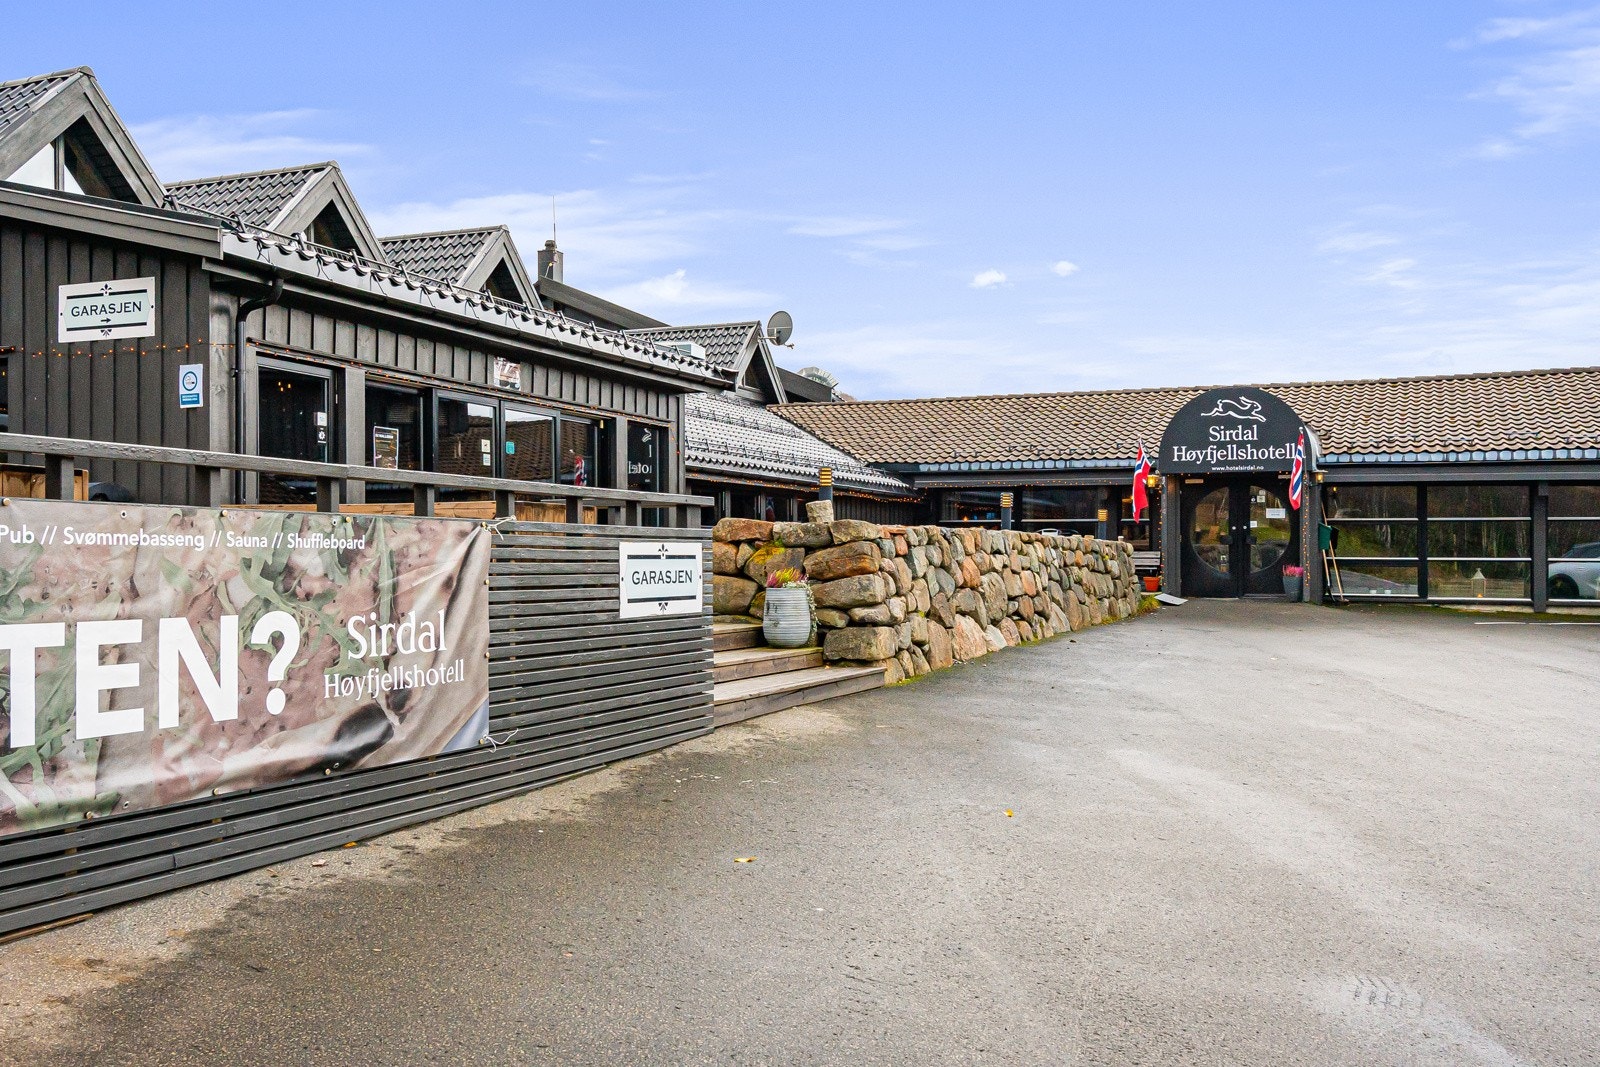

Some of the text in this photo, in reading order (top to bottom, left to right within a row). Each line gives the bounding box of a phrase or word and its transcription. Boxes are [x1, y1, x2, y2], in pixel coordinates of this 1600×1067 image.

[71, 301, 143, 318] GARASJEN
[1209, 426, 1258, 441] Sirdal
[1173, 444, 1295, 463] Høyfjellshotell
[0, 524, 35, 544] Pub
[63, 526, 205, 551] Svømmebasseng
[226, 532, 268, 549] Sauna
[287, 533, 365, 551] Shuffleboard
[631, 569, 693, 586] GARASJEN
[347, 610, 447, 660] Sirdal
[0, 610, 300, 749] TEN?
[324, 659, 465, 701] Høyfjellshotell
